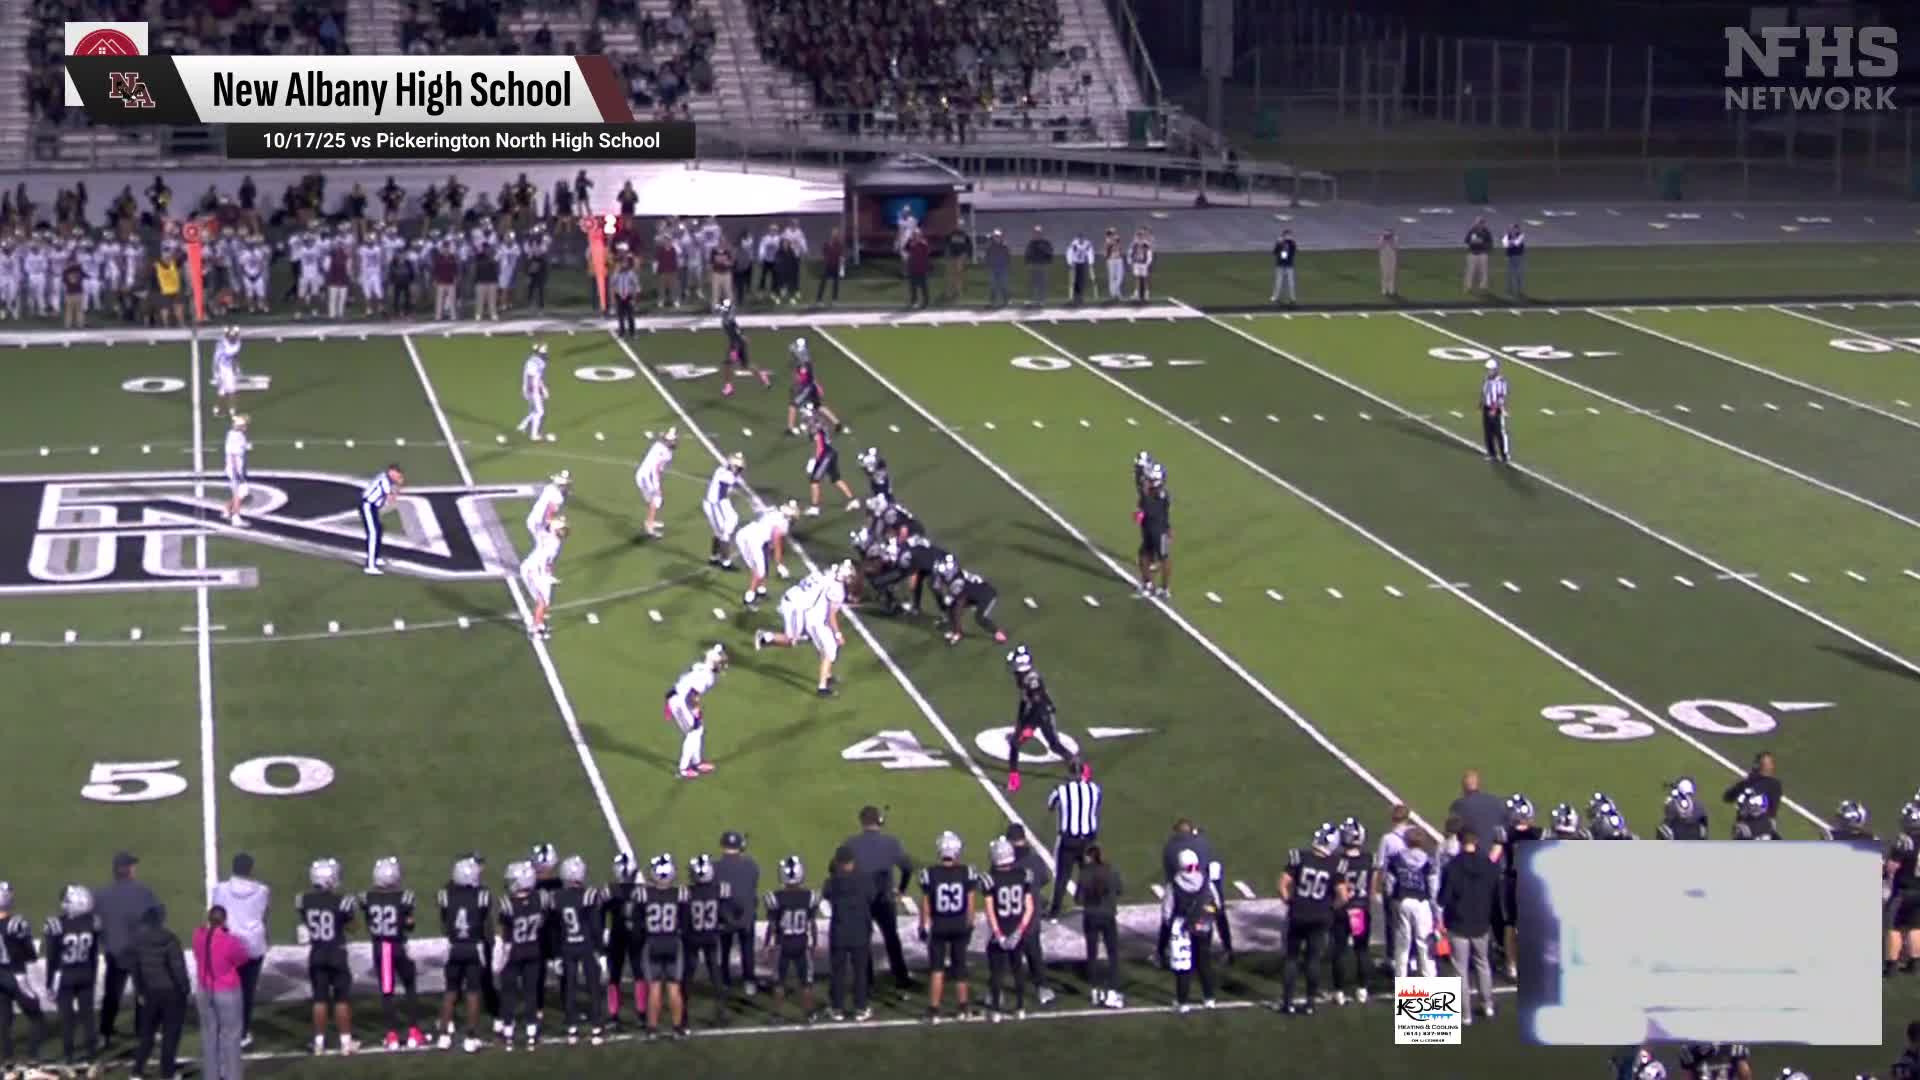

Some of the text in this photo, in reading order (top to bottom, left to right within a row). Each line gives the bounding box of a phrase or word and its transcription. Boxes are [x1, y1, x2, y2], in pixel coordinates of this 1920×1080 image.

[936, 882, 964, 912] 63
[1297, 867, 1331, 900] 56
[997, 884, 1024, 917] 99
[307, 908, 336, 941] 58
[369, 904, 398, 936] 32
[455, 908, 470, 938] 4
[513, 913, 543, 944] 27
[646, 903, 678, 932] 28
[780, 909, 807, 935] 40
